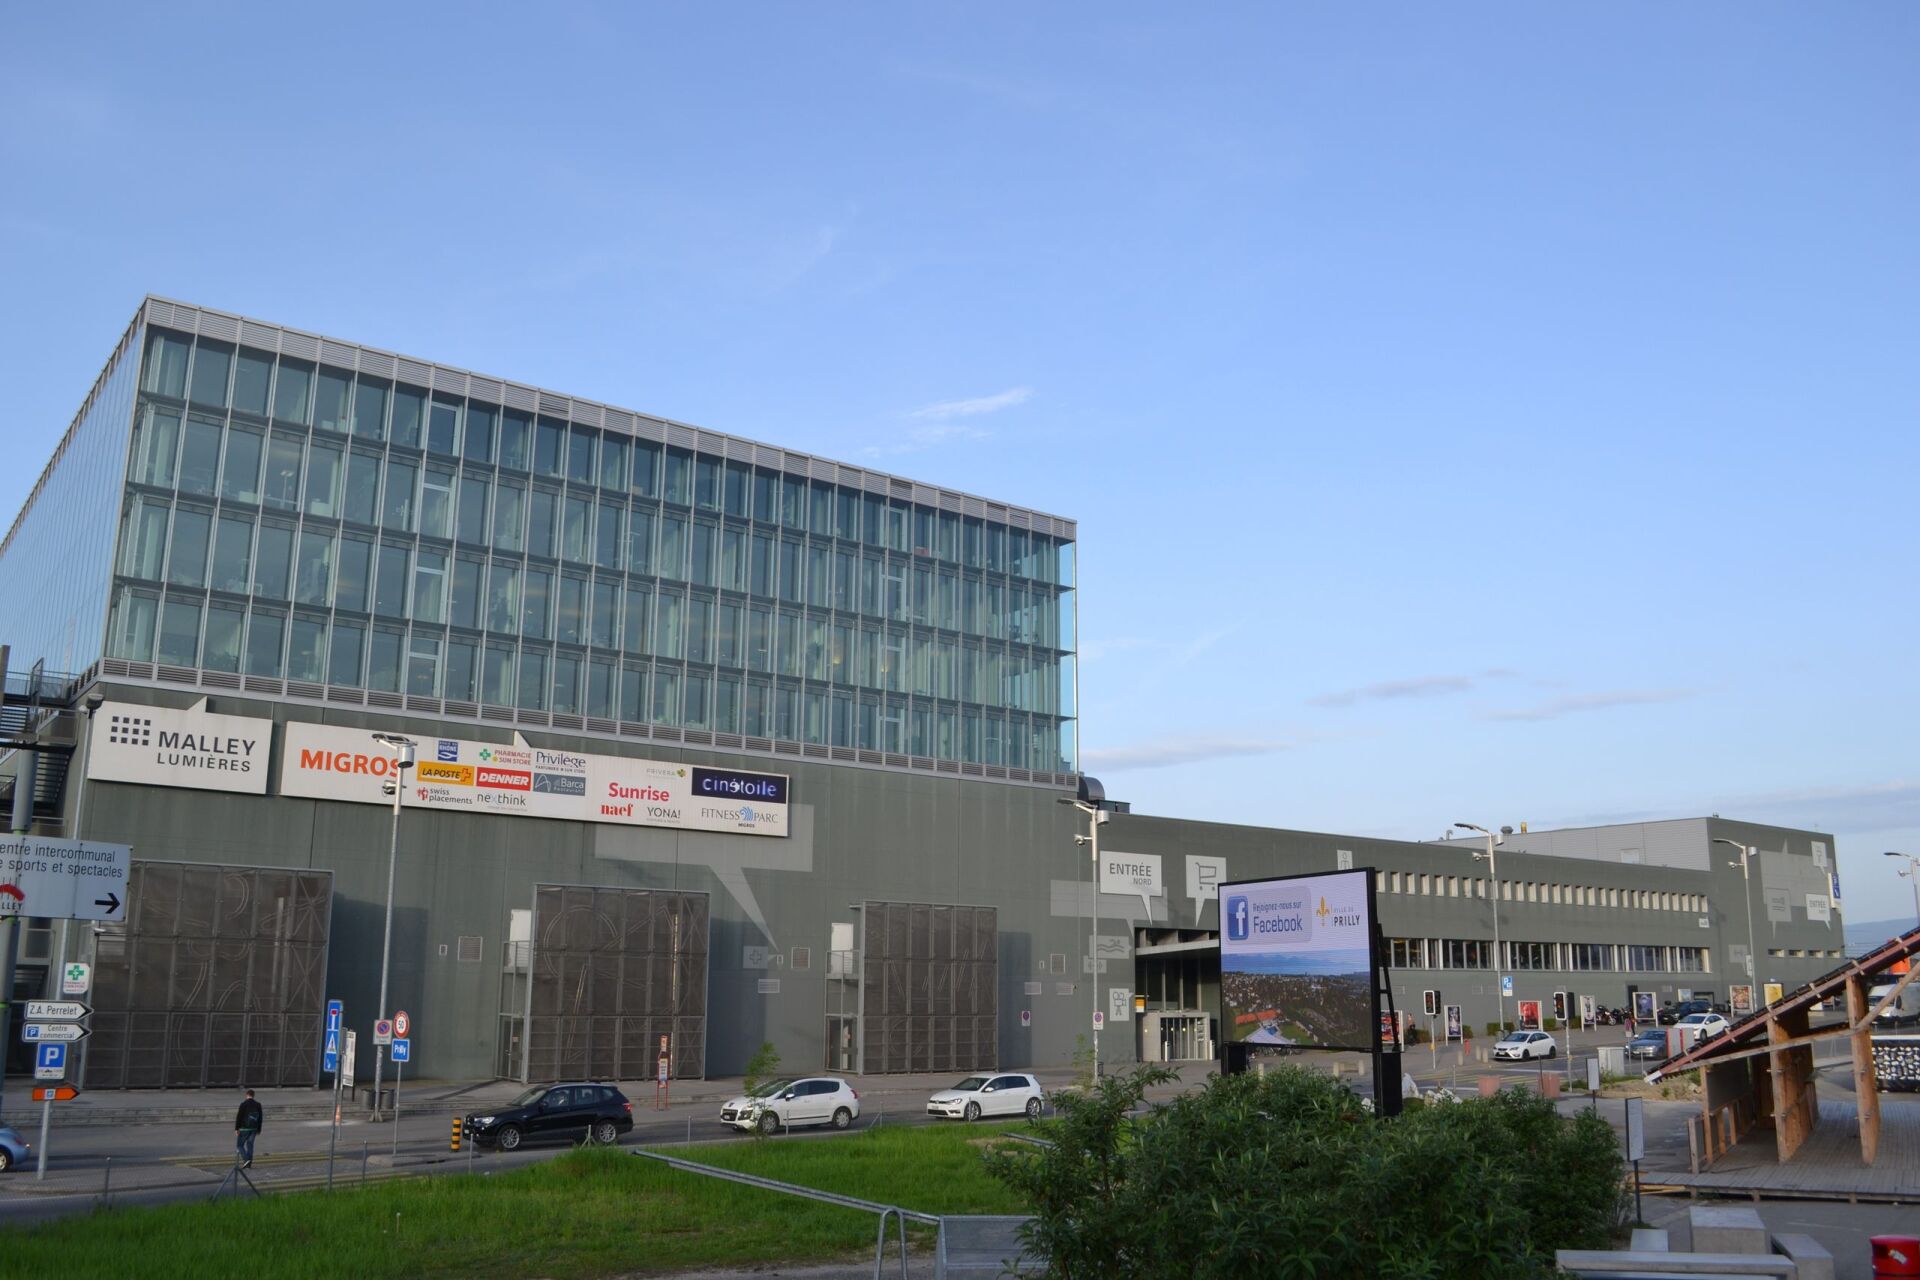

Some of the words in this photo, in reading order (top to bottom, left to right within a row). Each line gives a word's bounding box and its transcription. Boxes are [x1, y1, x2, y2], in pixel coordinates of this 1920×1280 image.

[159, 731, 256, 756] MALLEY
[494, 749, 531, 759] PHARMACIE
[157, 753, 251, 772] LUMIÈRES
[300, 749, 398, 778] MIGROS
[422, 768, 432, 776] LA
[434, 769, 460, 779] POSTE
[479, 772, 529, 786] DENNER
[429, 787, 450, 795] swiss
[608, 782, 670, 802] Sunrise
[429, 794, 473, 804] placements
[647, 807, 681, 819] YONA!
[701, 807, 740, 820] FITNESS
[754, 812, 779, 823] PARC
[0, 843, 30, 855] entre
[35, 844, 116, 862] intercommunal
[9, 860, 47, 872] sports
[52, 862, 63, 873] et
[68, 864, 122, 878] spectacles
[1109, 861, 1152, 877] ENTRÉE
[1133, 877, 1152, 885] NORD
[1, 902, 23, 910] LLEY
[1253, 913, 1302, 933] Facebook
[1333, 915, 1360, 927] PRILLY
[47, 1005, 78, 1015] Perrelet
[47, 1024, 68, 1032] Centre
[398, 1020, 404, 1029] 50
[45, 1047, 59, 1065] P
[394, 1044, 406, 1056] Prilly
